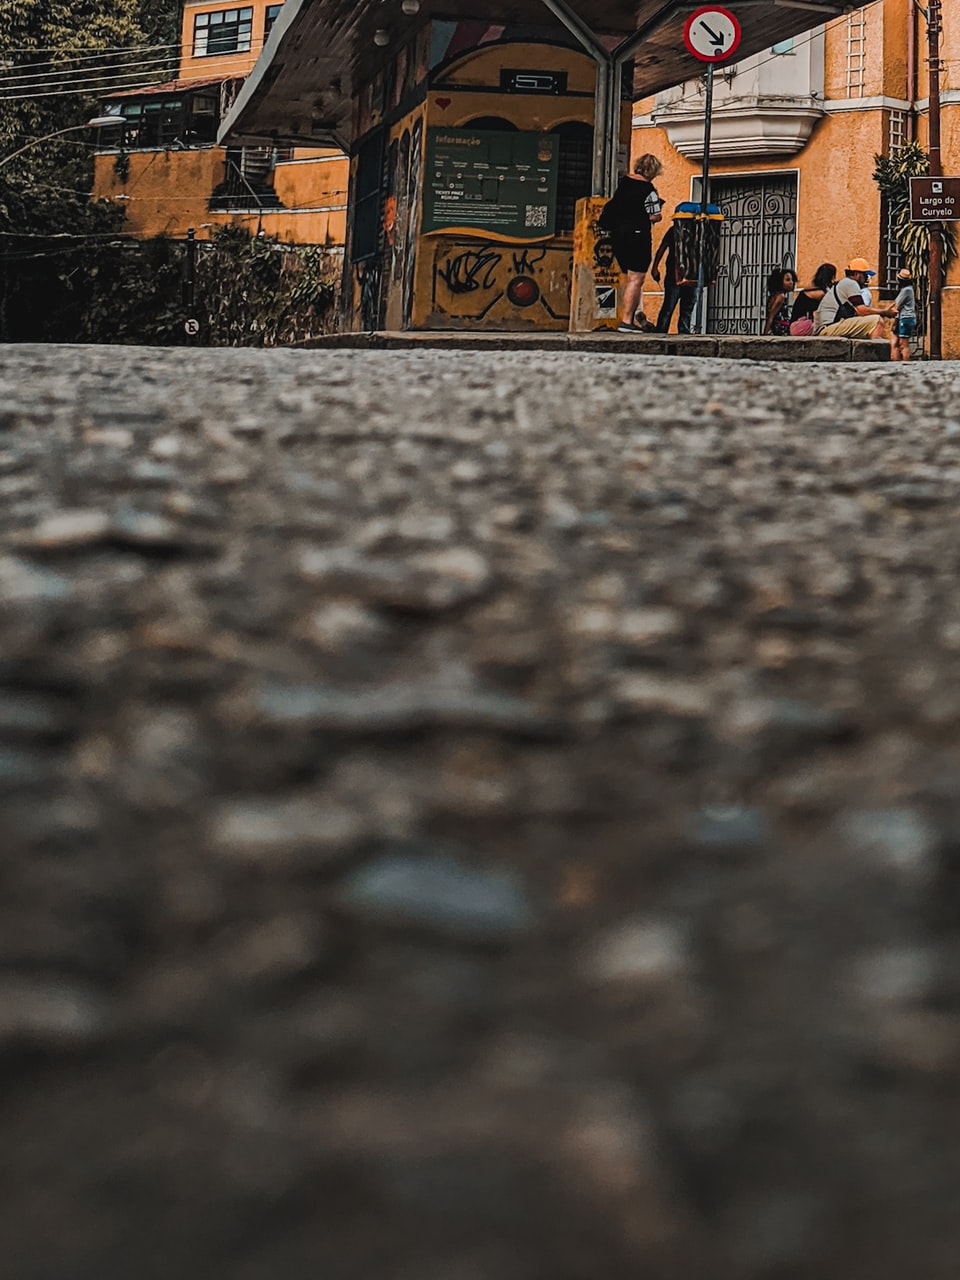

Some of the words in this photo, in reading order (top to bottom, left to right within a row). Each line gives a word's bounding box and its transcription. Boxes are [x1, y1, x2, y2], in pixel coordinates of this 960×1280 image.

[435, 135, 481, 146] Informação
[919, 197, 943, 206] Largo
[945, 196, 955, 204] do
